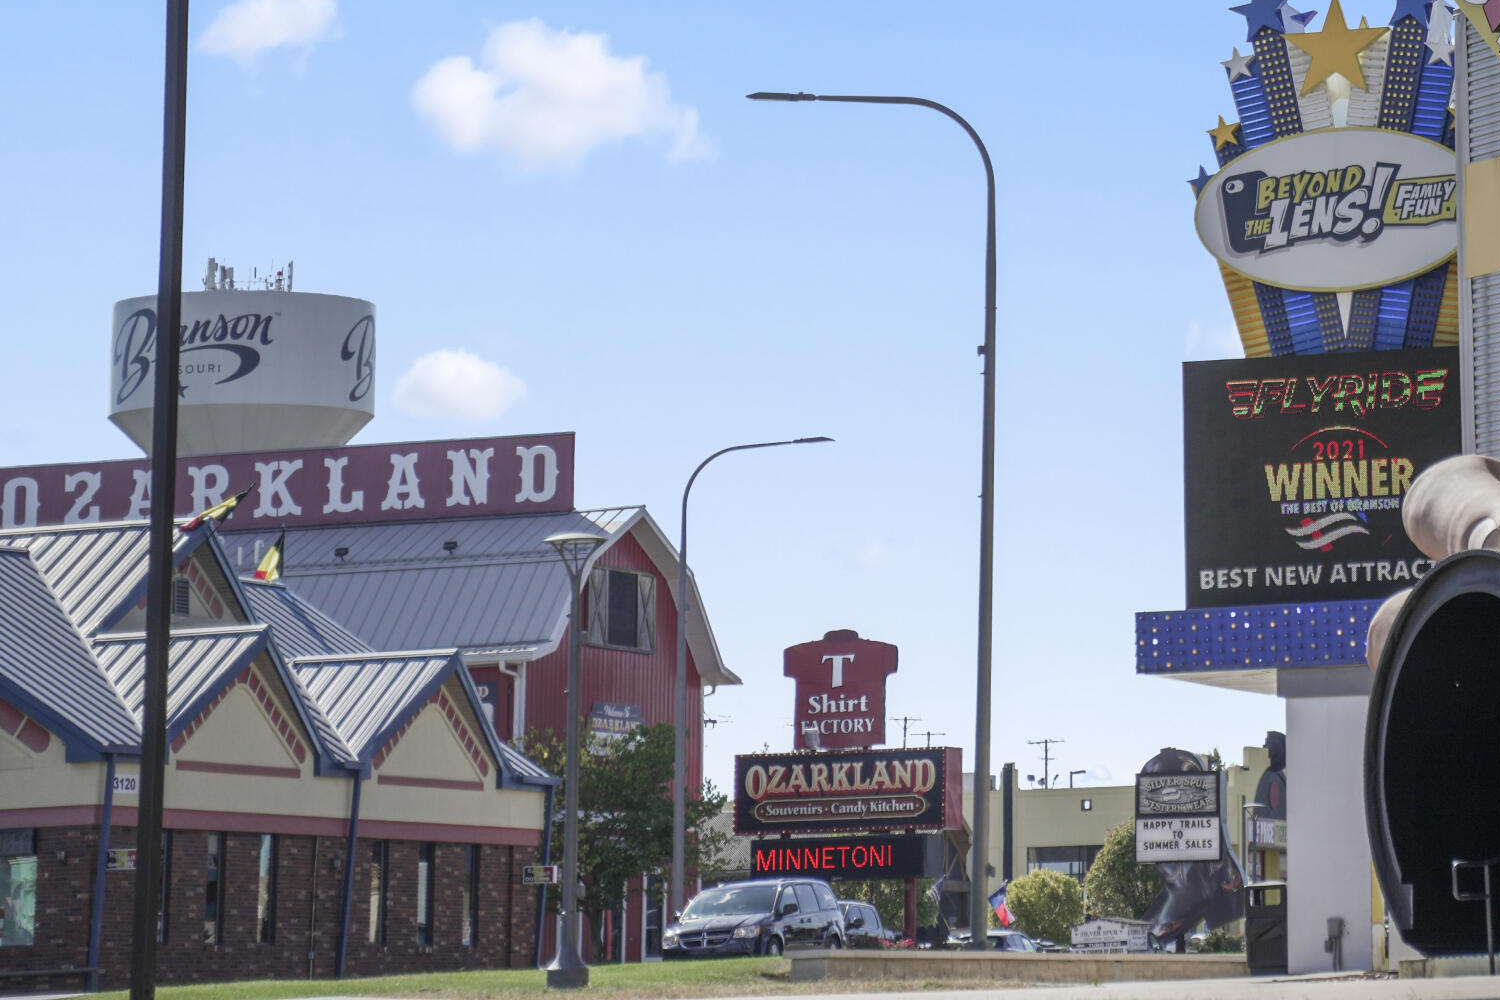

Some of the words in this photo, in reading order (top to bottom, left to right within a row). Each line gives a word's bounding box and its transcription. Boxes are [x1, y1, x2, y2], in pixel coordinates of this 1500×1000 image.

[1256, 165, 1365, 210] BEYOND
[1396, 179, 1456, 208] FAMILY
[1246, 218, 1272, 237] THE
[1264, 165, 1396, 250] LENS!
[1401, 198, 1443, 220] FUN
[113, 308, 274, 405] Banson
[1225, 368, 1449, 419] FLYRIDE
[1312, 439, 1365, 461] 2021
[1, 445, 557, 529] OZARKLAND
[1264, 457, 1415, 502] WINNER
[1280, 502, 1300, 515] THE
[1303, 501, 1328, 514] BEST
[1331, 500, 1344, 513] OF
[1348, 498, 1401, 512] BRANSON
[1199, 568, 1257, 590] BEST
[1264, 564, 1323, 587] NEW
[821, 654, 855, 688] T
[807, 693, 870, 715] Shirt
[800, 717, 875, 735] FACTORY
[113, 777, 136, 790] 3120
[745, 759, 936, 800] OZARKLAND
[1145, 776, 1180, 792] SILVER
[1182, 776, 1209, 791] SPUR
[765, 804, 823, 817] Souvenirs
[830, 801, 868, 817] Candy
[870, 800, 915, 813] Kitchen
[1143, 799, 1184, 812] WESTERN
[1185, 797, 1210, 812] WEAR
[1143, 820, 1173, 830] HAPPY
[1180, 819, 1212, 829] TRAILS
[1172, 831, 1183, 839] TO
[1143, 841, 1179, 850] SUMMER
[1185, 840, 1212, 849] SALES
